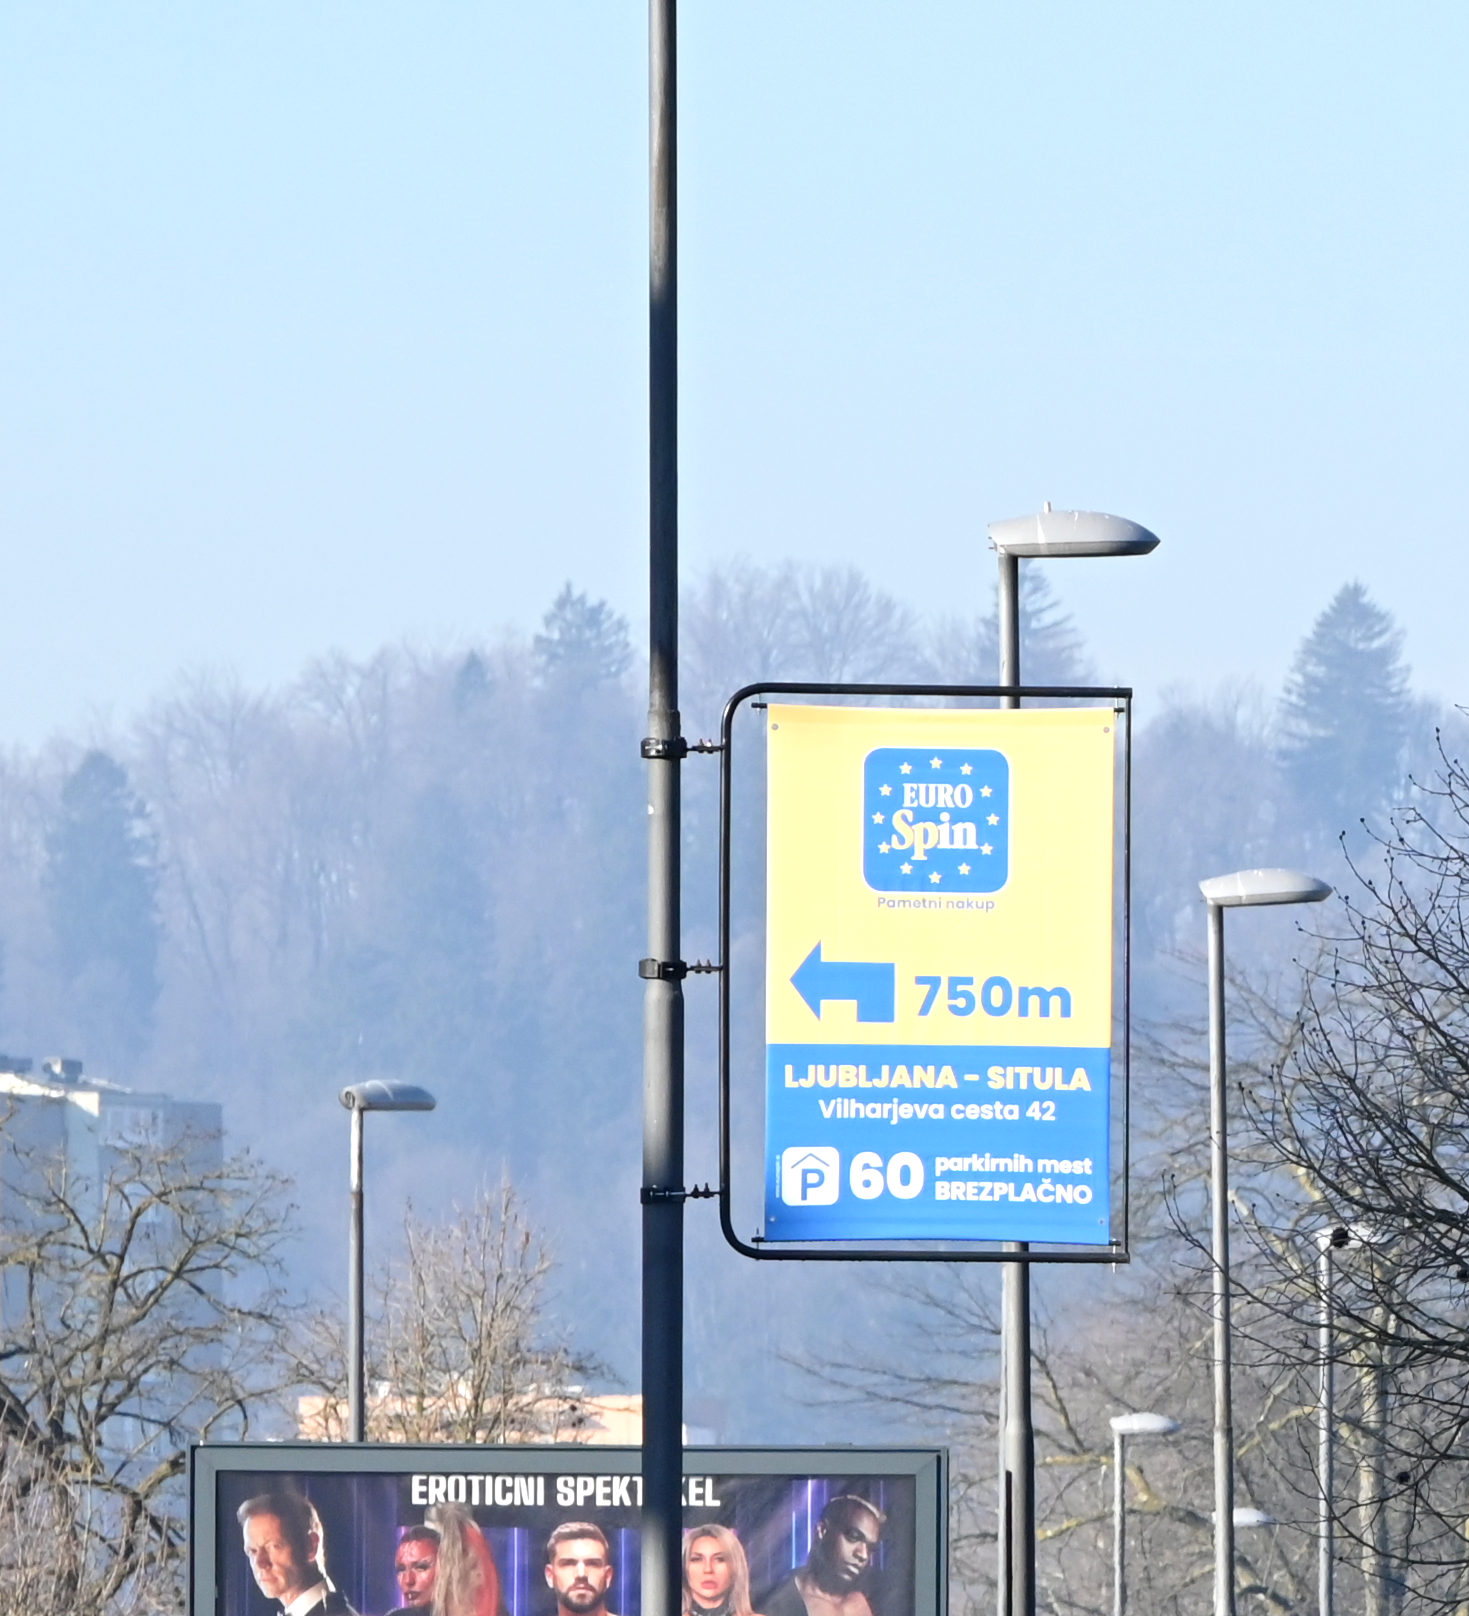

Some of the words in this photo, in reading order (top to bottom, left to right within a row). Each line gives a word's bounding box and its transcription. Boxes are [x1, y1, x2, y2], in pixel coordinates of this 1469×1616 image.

[902, 783, 973, 809] EURO
[890, 810, 979, 860] Spin
[878, 897, 942, 910] Pametni
[945, 898, 995, 912] nakup
[914, 975, 1073, 1018] 750m
[784, 1064, 958, 1090] LJUBLJANA
[987, 1065, 1092, 1091] SITULA
[818, 1098, 945, 1125] Vilharjeva
[951, 1102, 1019, 1121] cesta
[1026, 1100, 1056, 1121] 42
[849, 1151, 925, 1199] 60
[935, 1153, 1033, 1176] parkirnih
[1037, 1156, 1093, 1175] mest
[935, 1180, 1093, 1205] BREZPLAČNO
[556, 1475, 721, 1507] SPEKTEL
